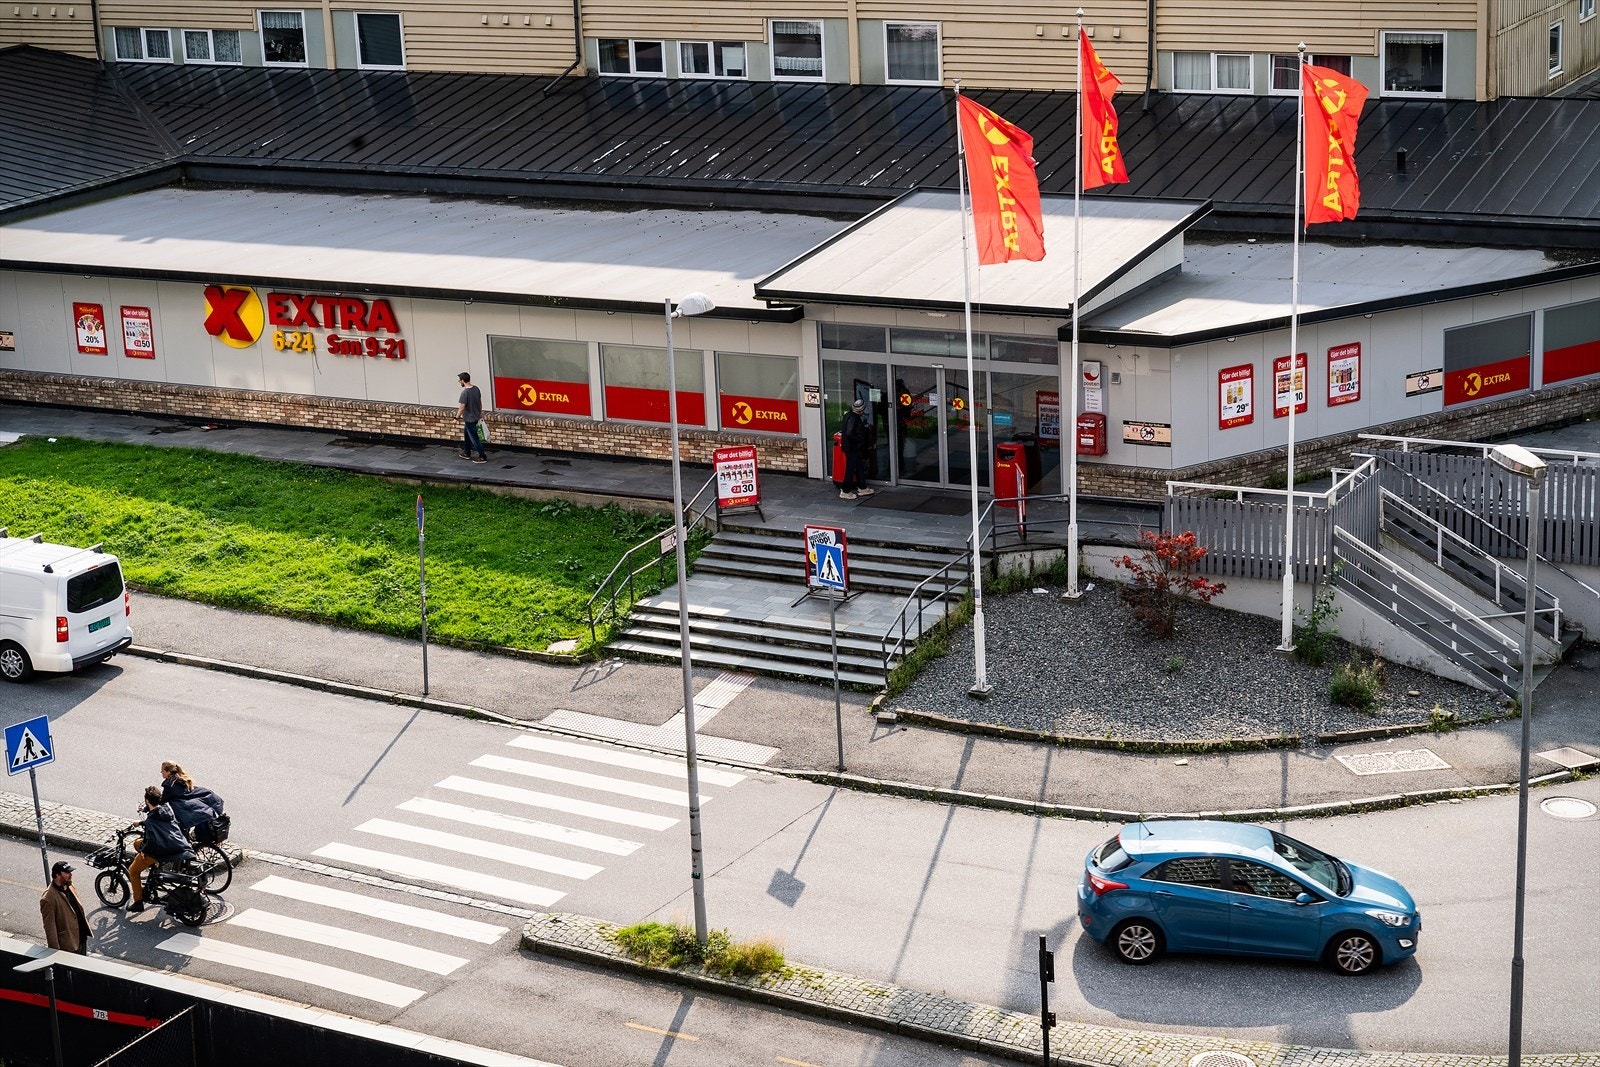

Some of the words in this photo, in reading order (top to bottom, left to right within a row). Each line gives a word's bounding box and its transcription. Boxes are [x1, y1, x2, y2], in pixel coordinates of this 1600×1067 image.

[267, 292, 400, 334] EXTRA
[84, 336, 100, 344] -20%
[141, 340, 150, 348] 50
[273, 329, 315, 353] 6-24
[365, 337, 406, 360] 9-21
[1277, 357, 1303, 369] Partire!
[1483, 373, 1511, 386] EXTRA
[539, 392, 570, 403] EXTRA
[1295, 391, 1303, 401] 10
[755, 410, 788, 421] EXTRA
[729, 451, 738, 459] det
[742, 484, 754, 493] 30
[95, 1010, 105, 1019] 78
